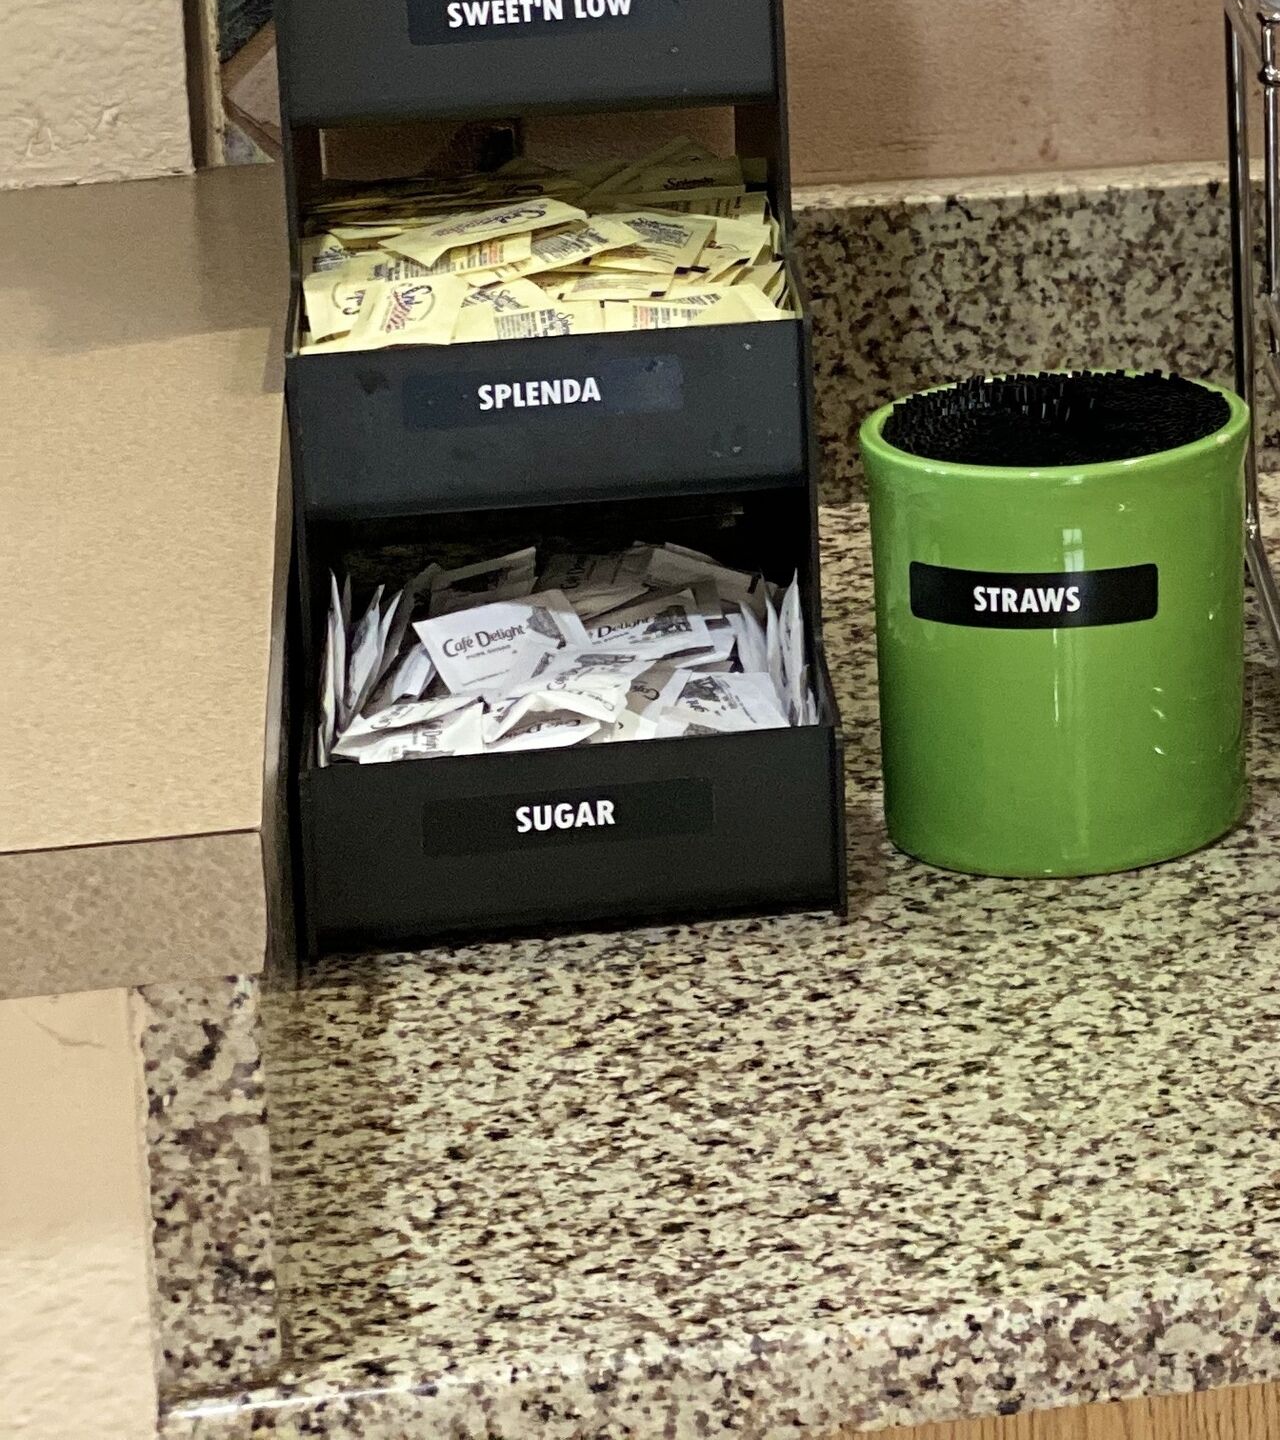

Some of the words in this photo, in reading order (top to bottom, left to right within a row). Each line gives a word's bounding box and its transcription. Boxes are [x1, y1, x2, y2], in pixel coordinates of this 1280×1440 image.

[477, 377, 602, 411] SPLENDA
[973, 586, 1081, 613] STRAWS
[442, 635, 474, 658] Café
[475, 624, 527, 647] Delight
[516, 800, 616, 834] SUGAR
